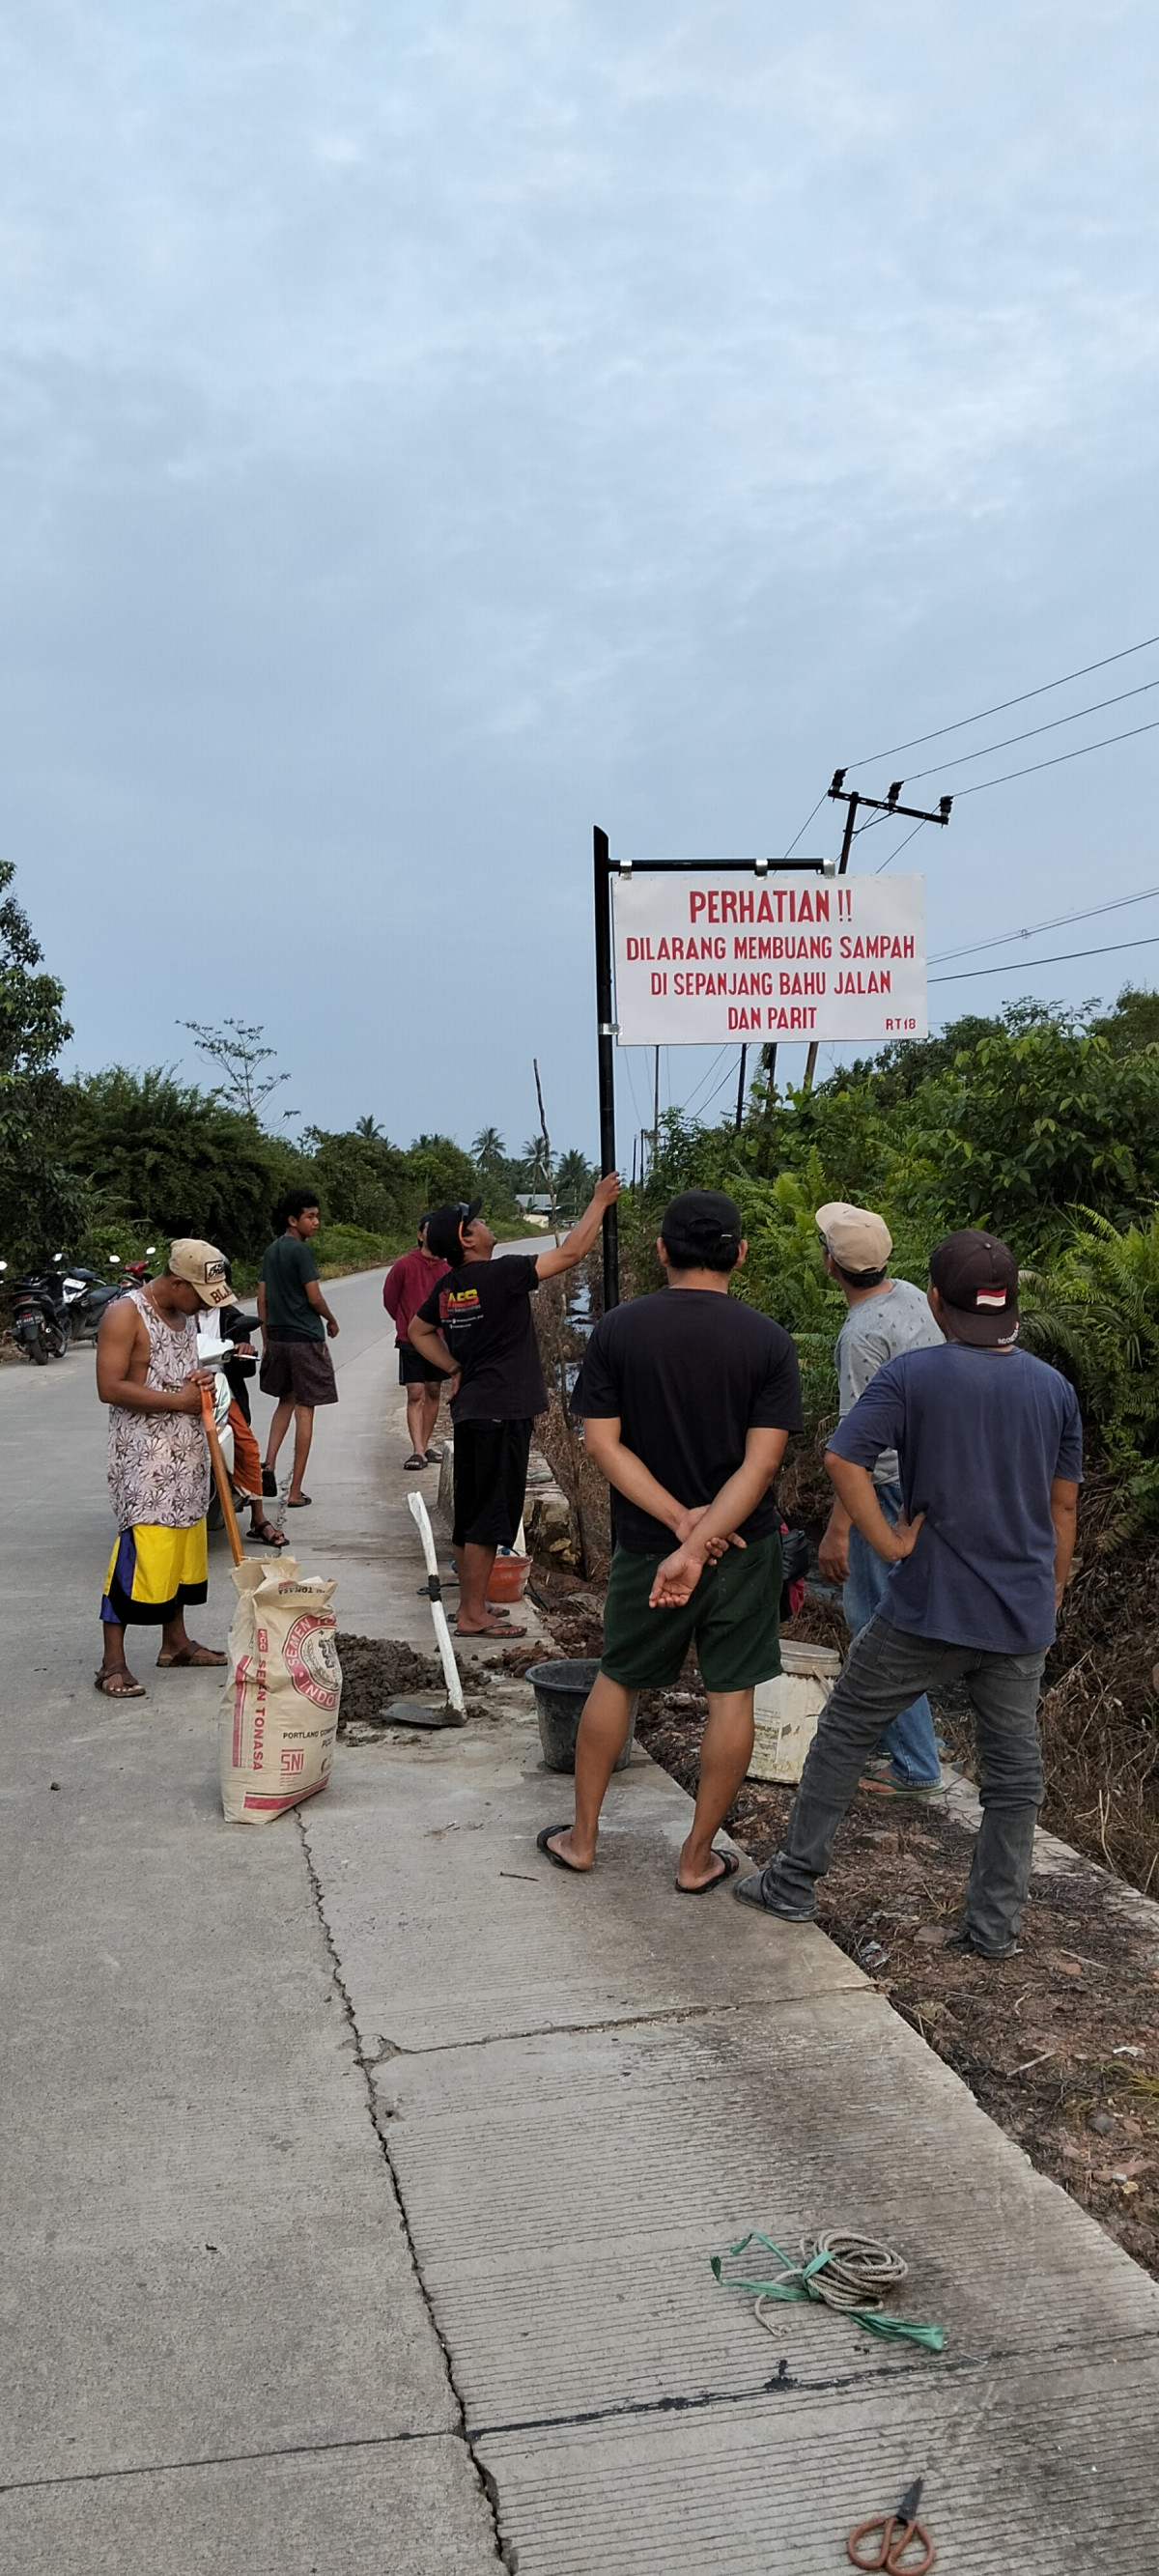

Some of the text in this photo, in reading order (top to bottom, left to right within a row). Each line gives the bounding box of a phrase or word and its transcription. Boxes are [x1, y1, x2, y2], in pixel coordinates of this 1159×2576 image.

[690, 889, 852, 923] PERHATIAN !!
[626, 935, 915, 961] DILARANG MEMBUANG SAMPAH
[651, 971, 891, 996] DI SEPANJANG BAHU JALAN
[727, 1006, 817, 1031] DAN PARIT
[286, 1617, 312, 1667] SEMEN
[253, 1707, 266, 1771] TONASA
[283, 1730, 319, 1740] PORTLAND
[280, 1752, 304, 1771] SNI
